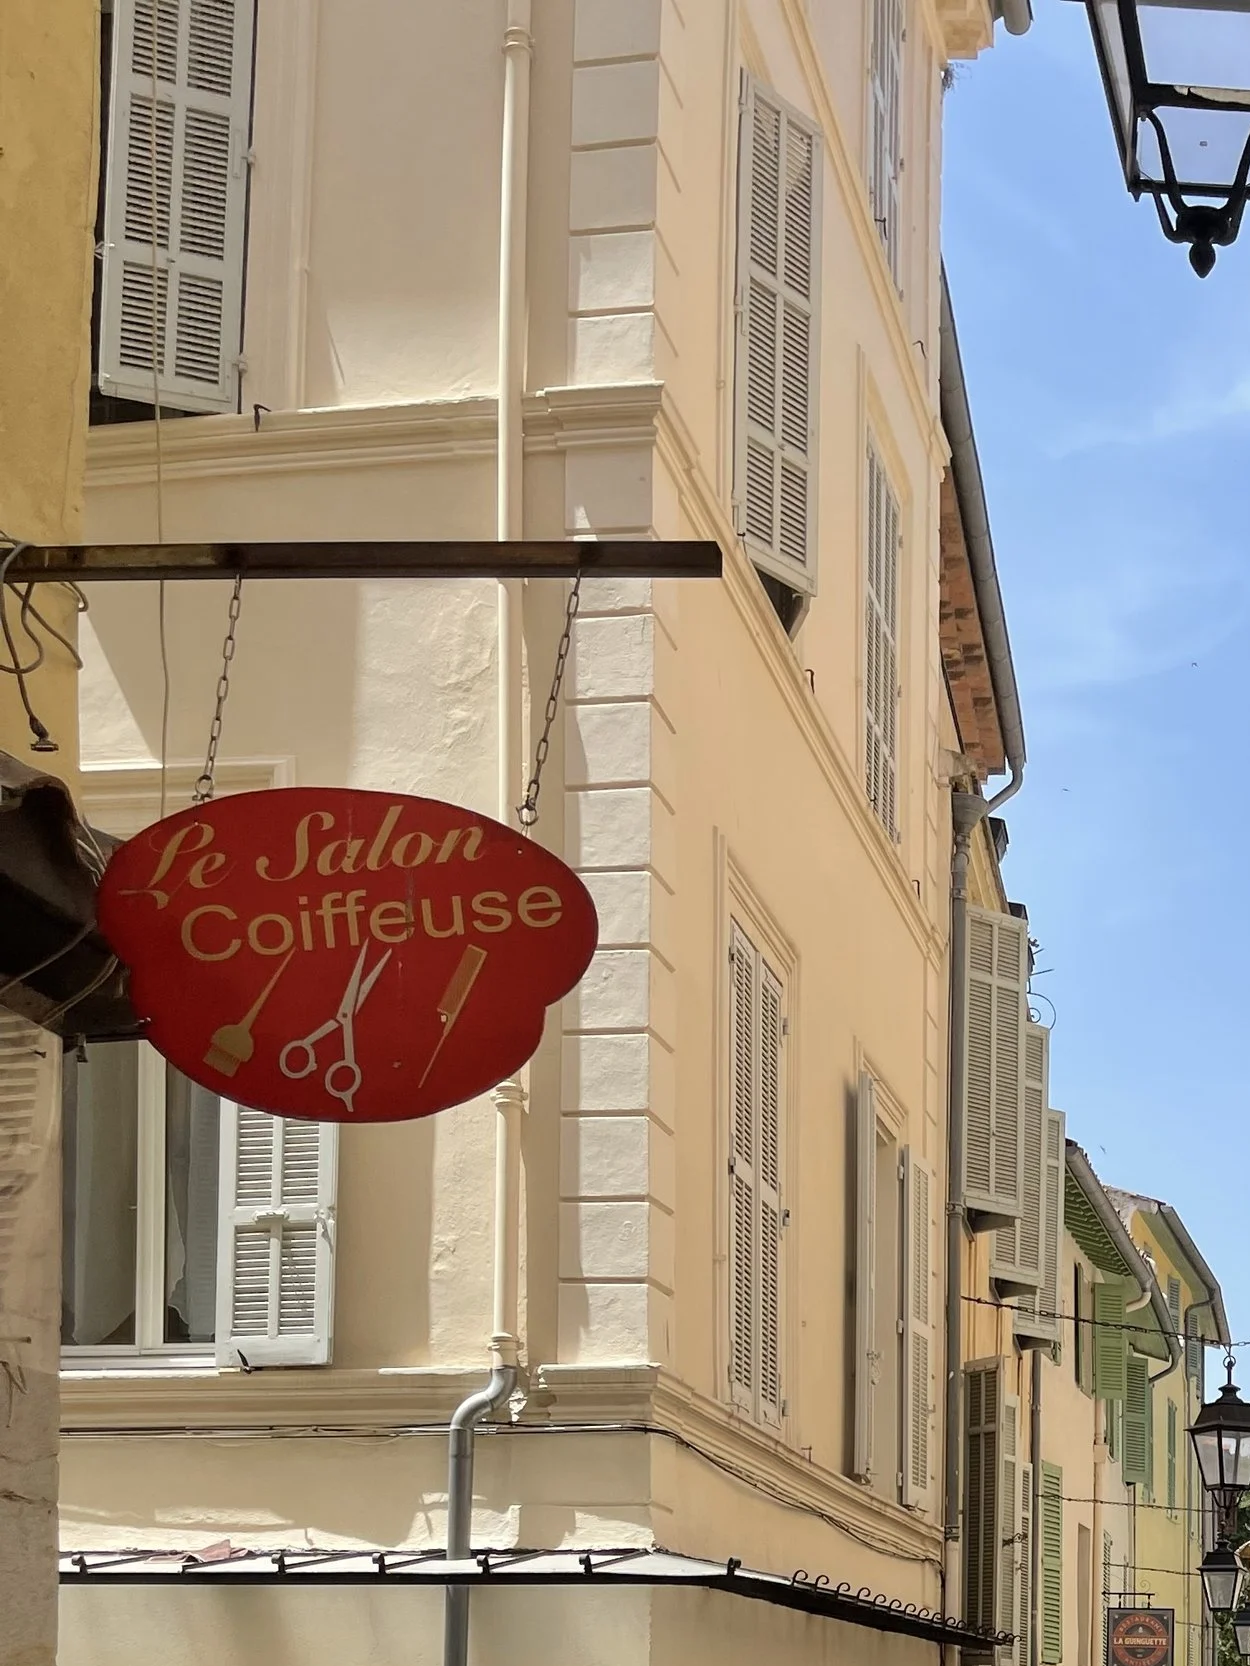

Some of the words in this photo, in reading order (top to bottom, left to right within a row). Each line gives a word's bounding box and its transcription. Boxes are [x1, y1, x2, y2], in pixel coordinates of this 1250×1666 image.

[117, 822, 236, 909] Le
[256, 804, 488, 883] Salon
[181, 884, 563, 962] Coiffeuse
[1113, 1637, 1123, 1645] LA
[1124, 1637, 1167, 1646] GUINGUETTE
